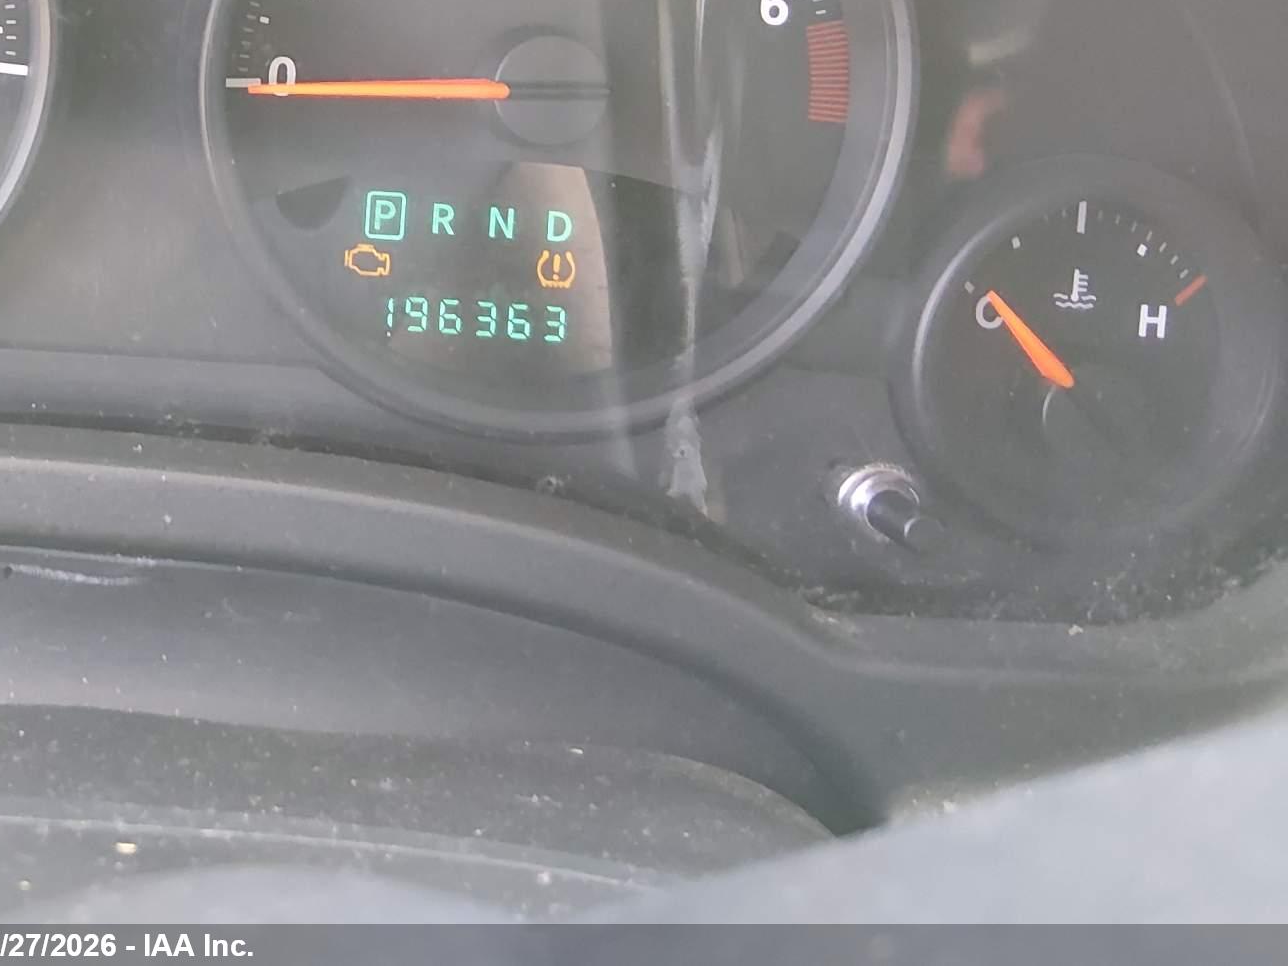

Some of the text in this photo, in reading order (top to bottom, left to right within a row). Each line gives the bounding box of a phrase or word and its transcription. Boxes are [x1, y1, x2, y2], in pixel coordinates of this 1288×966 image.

[267, 56, 297, 96] 0
[375, 200, 573, 242] P R N D
[386, 296, 567, 340] 196363
[975, 295, 1003, 330] C
[1139, 304, 1167, 339] H
